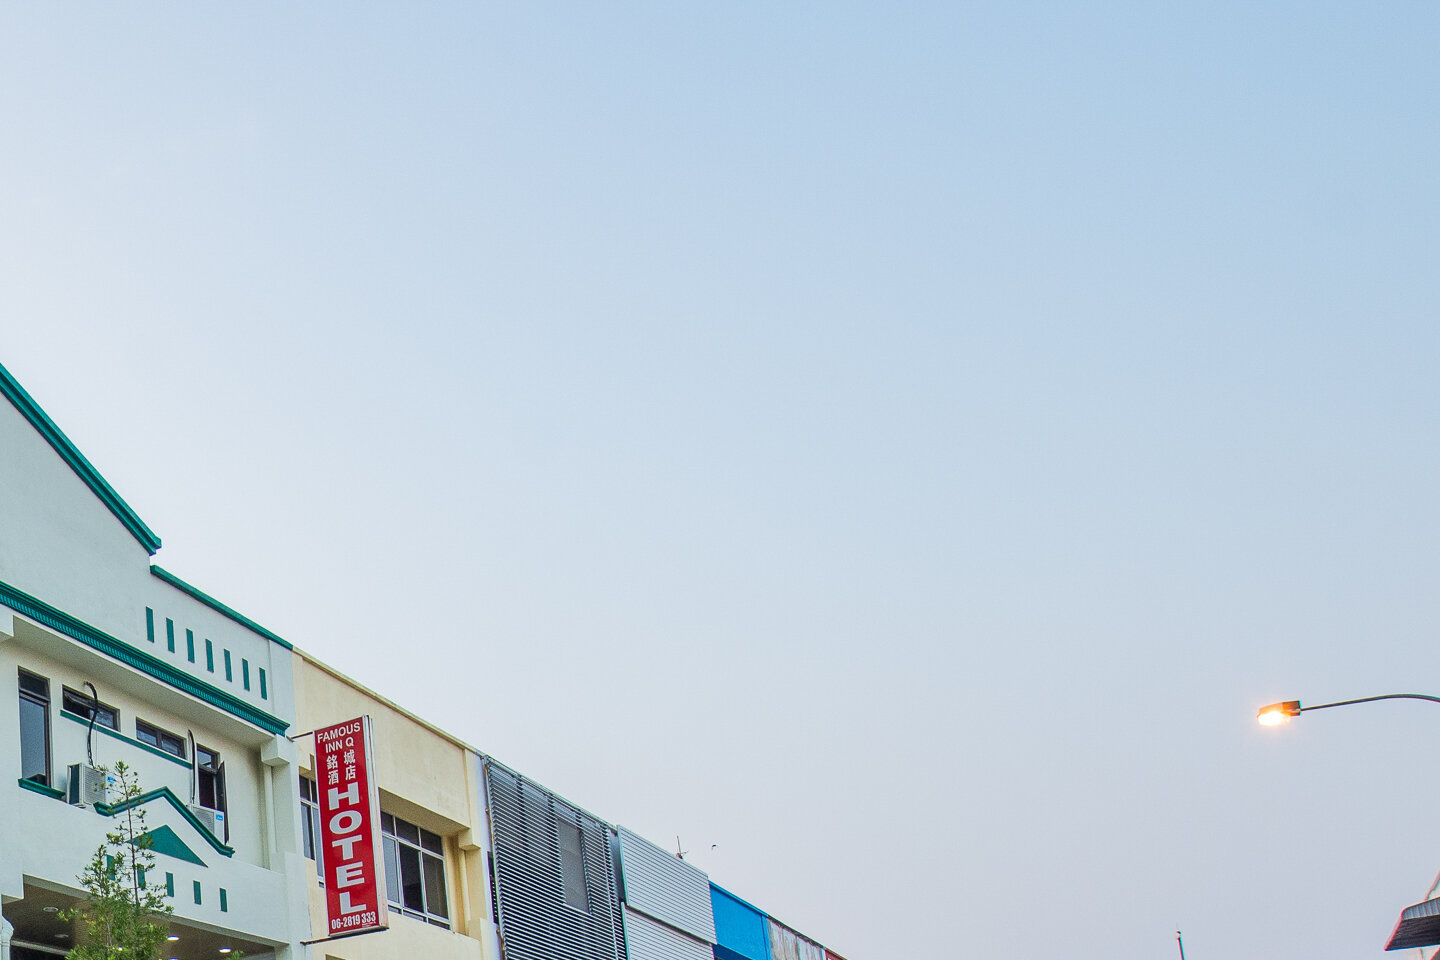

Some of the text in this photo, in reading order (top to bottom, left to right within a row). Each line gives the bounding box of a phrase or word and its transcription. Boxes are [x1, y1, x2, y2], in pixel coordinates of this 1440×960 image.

[318, 722, 360, 744] FAMOUS
[325, 736, 354, 754] INN Q
[328, 782, 367, 916] HOTEL
[331, 914, 360, 930] 06-2819
[361, 912, 376, 924] 333
